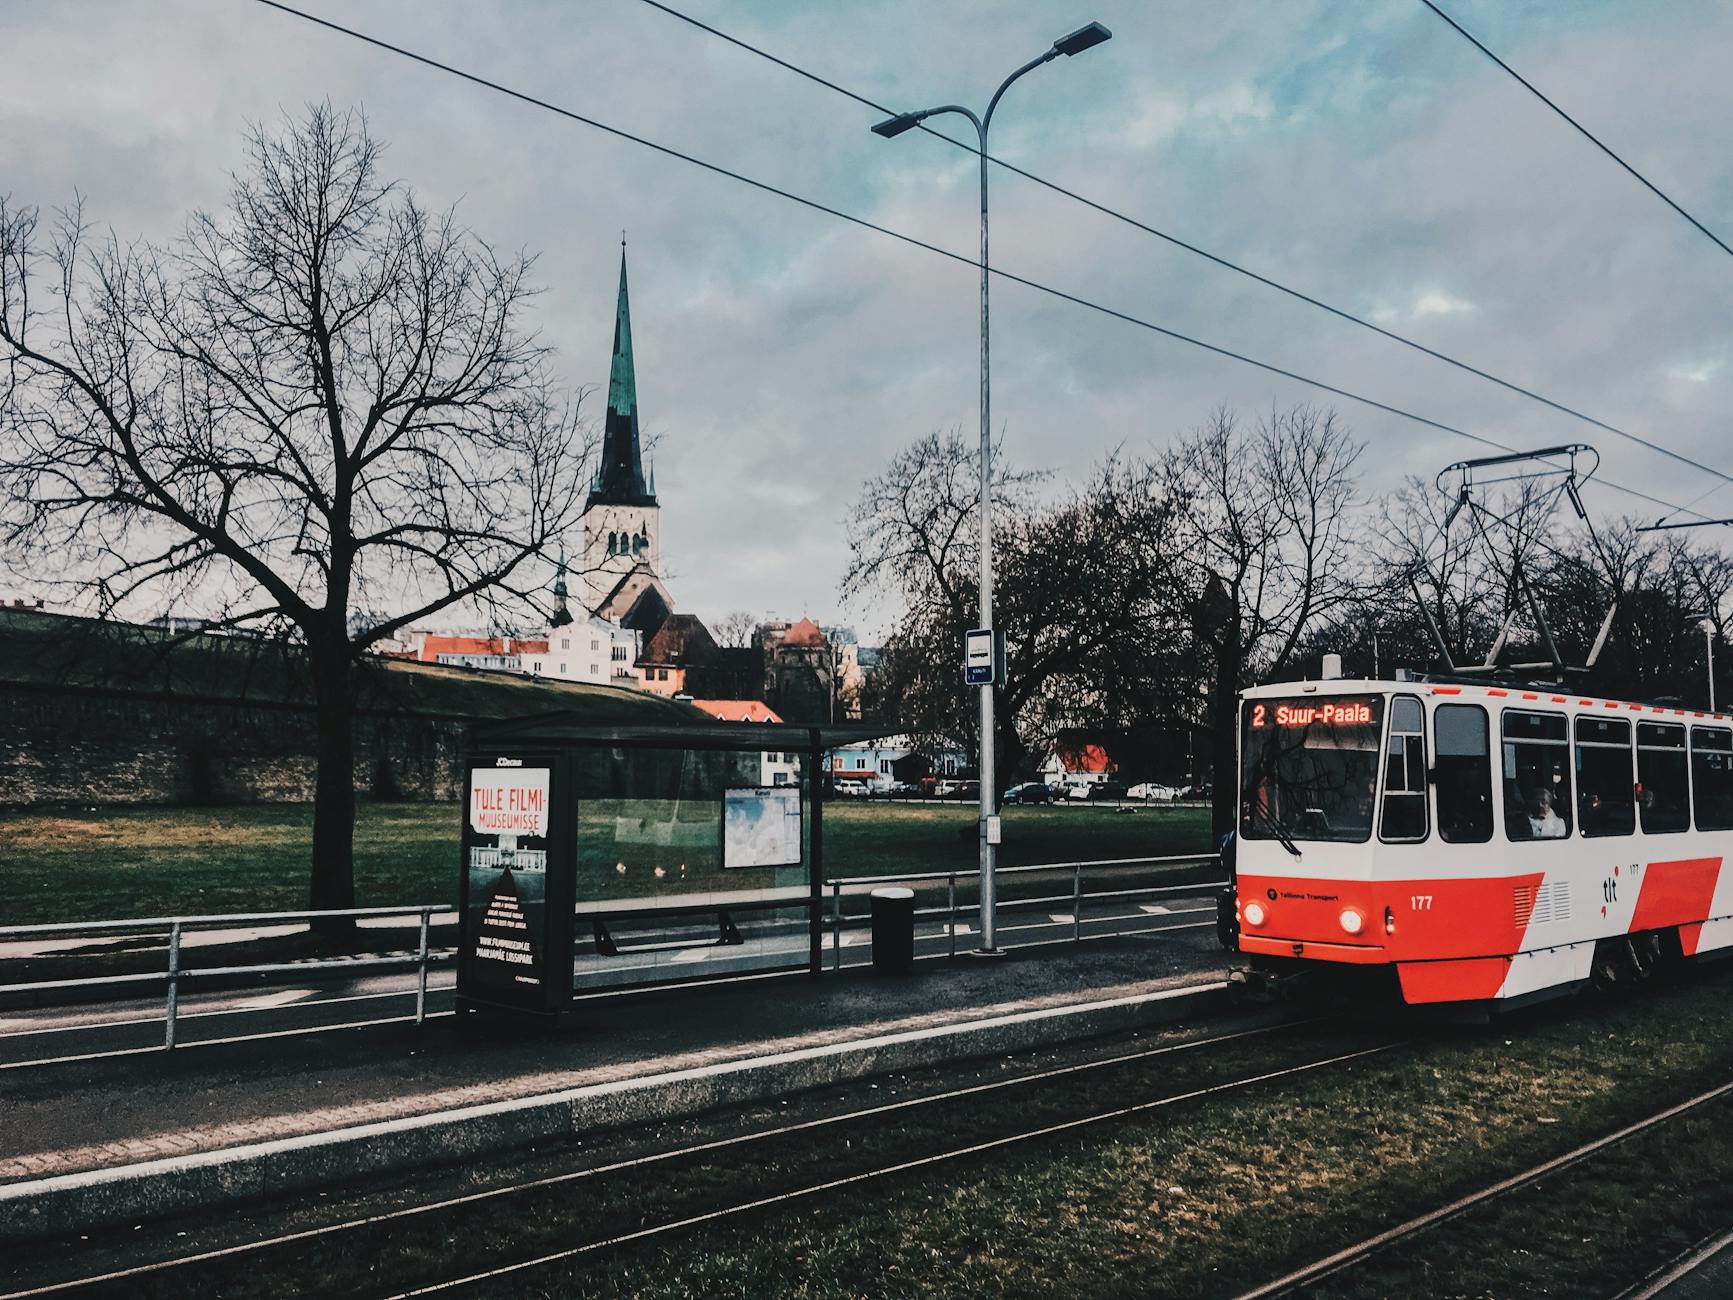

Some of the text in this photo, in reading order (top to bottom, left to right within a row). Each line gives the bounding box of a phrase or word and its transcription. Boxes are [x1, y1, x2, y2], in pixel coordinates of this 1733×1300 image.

[1253, 703, 1370, 726] 2 Suur-Paala
[474, 788, 503, 811] TULE
[479, 813, 540, 830] MUUSEUMISSE
[1410, 895, 1433, 911] 177
